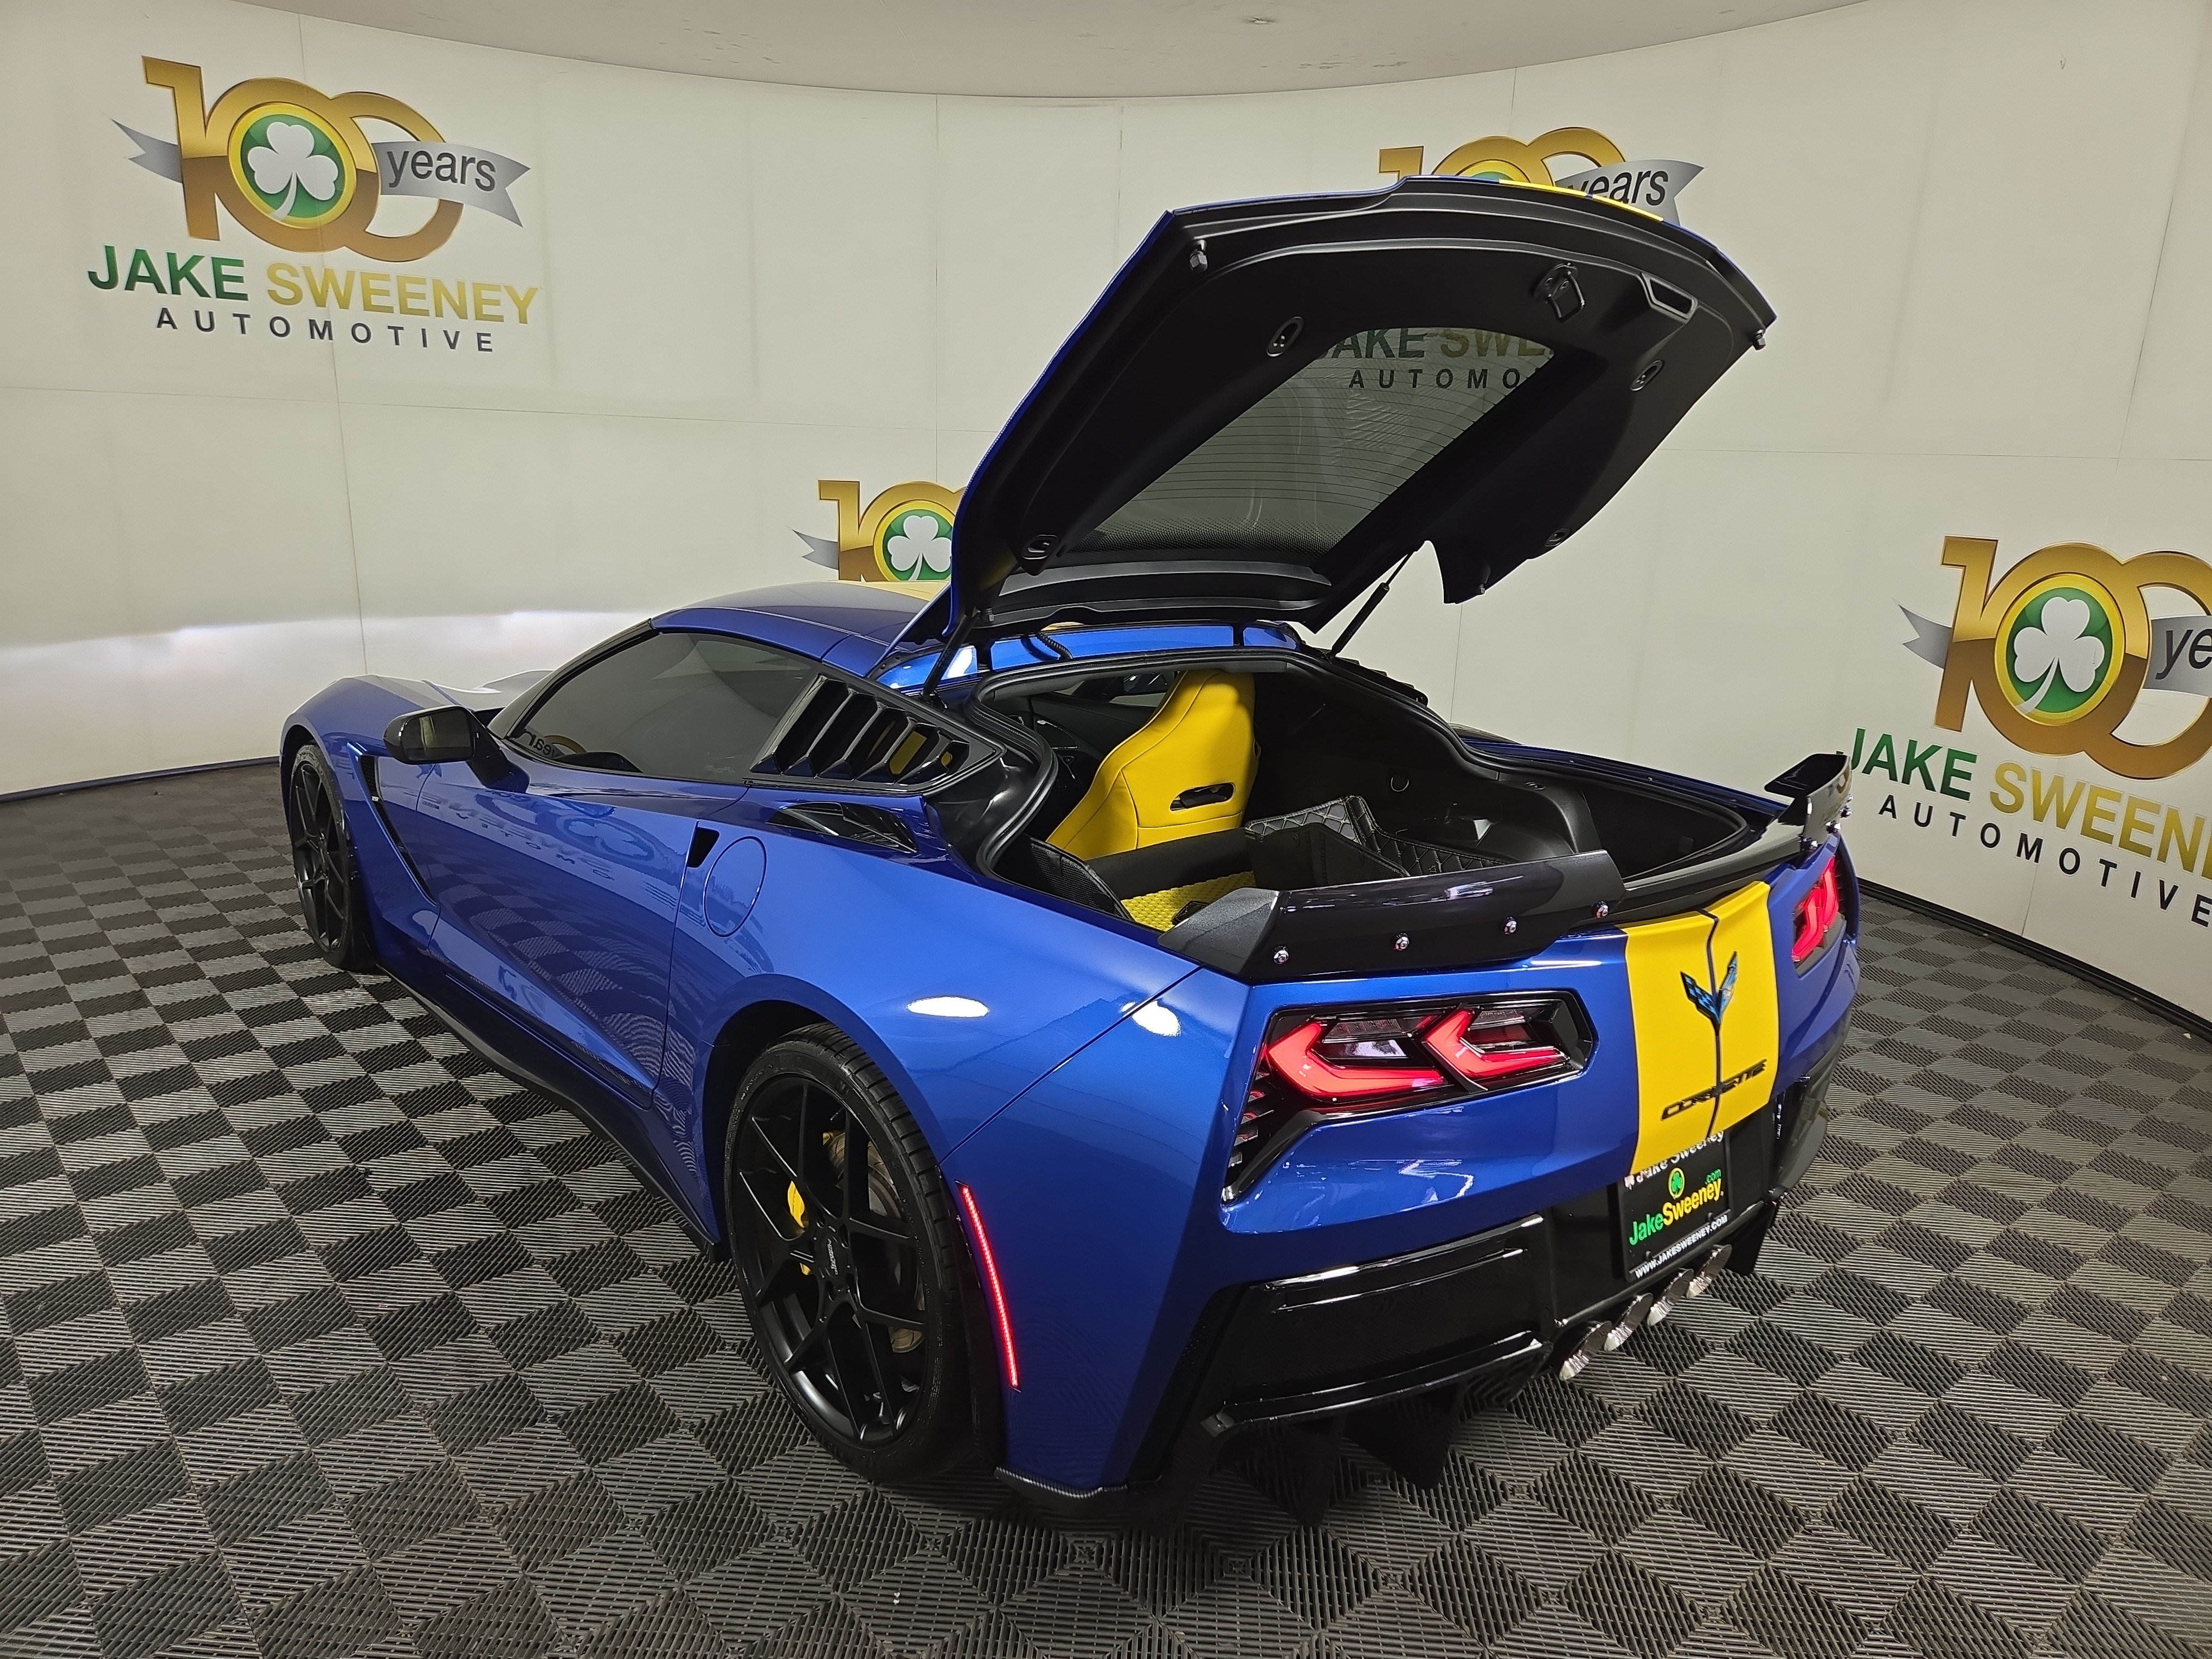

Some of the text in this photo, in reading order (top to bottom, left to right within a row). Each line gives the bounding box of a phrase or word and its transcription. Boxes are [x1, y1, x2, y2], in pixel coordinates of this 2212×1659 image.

[142, 56, 497, 262] 100 years
[88, 245, 541, 324] JAKE SWEENEY
[157, 307, 493, 352] AUTOMOTIVE
[1324, 327, 1425, 358] AKE
[1349, 368, 1532, 389] AUTOMO
[1836, 728, 1978, 801] JAKE
[1879, 794, 2212, 927] AUTOMOTIVE
[1635, 1214, 1728, 1278] WWW.JAKESWEENEY.COM
